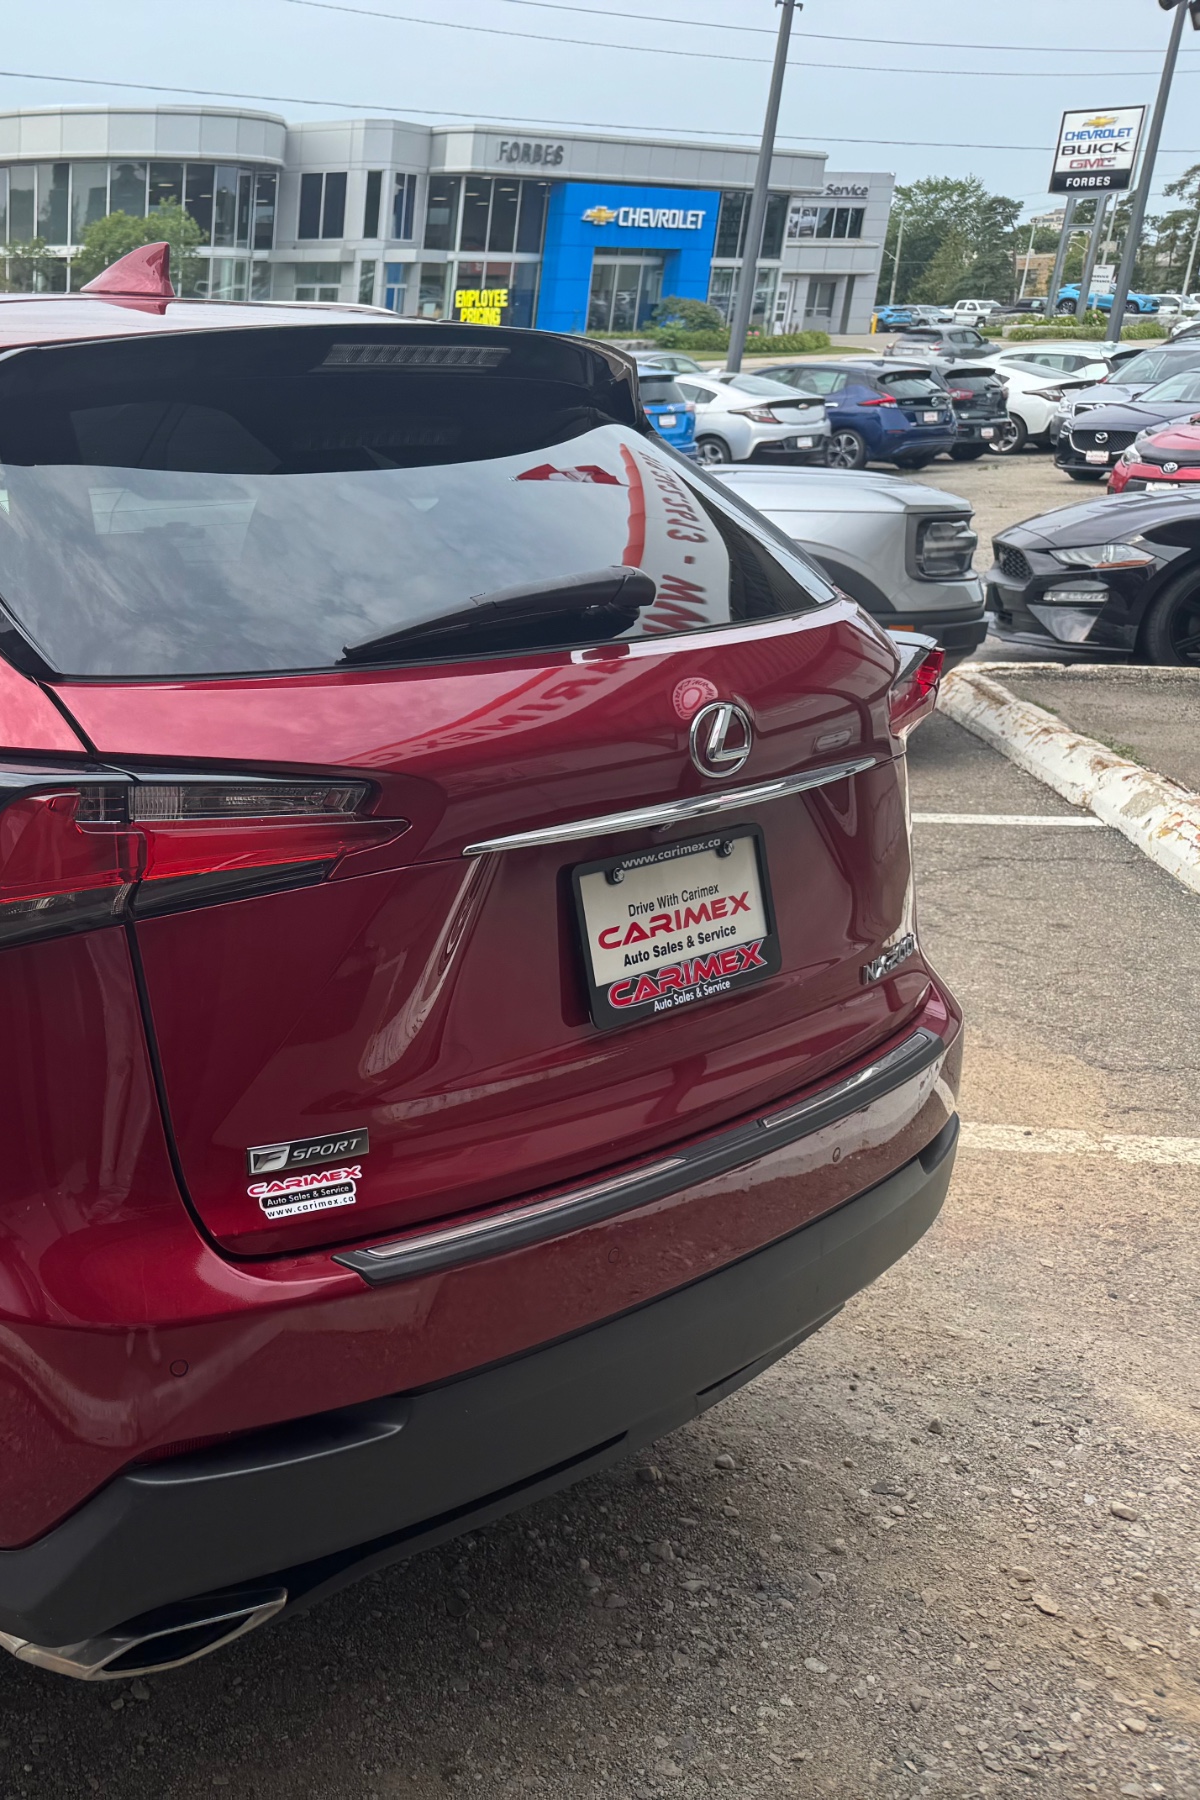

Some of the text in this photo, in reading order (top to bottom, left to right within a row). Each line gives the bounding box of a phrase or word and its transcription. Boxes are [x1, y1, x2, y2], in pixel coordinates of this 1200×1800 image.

[1064, 128, 1134, 141] CHEVROLET
[498, 141, 565, 166] FORBES
[1061, 141, 1130, 156] BUICK
[1070, 156, 1116, 169] GMC
[826, 184, 868, 196] Service
[1066, 176, 1111, 188] FORBES
[618, 206, 706, 230] CHEVROLET
[455, 289, 508, 308] EMPLOYEE
[460, 308, 501, 326] PRICING
[622, 838, 721, 868] www.carimex.ca
[628, 884, 720, 917] Drive With Carimex
[598, 891, 751, 950] CARIMEX
[624, 924, 737, 967] Auto Sales & Service
[608, 941, 766, 1008] CARIMEX
[654, 980, 731, 1012] Auto Sales & Service
[291, 1138, 362, 1161] SPORT
[249, 1166, 360, 1196] CARIMEX
[267, 1185, 349, 1207] Auto Sales & Service
[268, 1196, 355, 1218] www.carimex.ca
